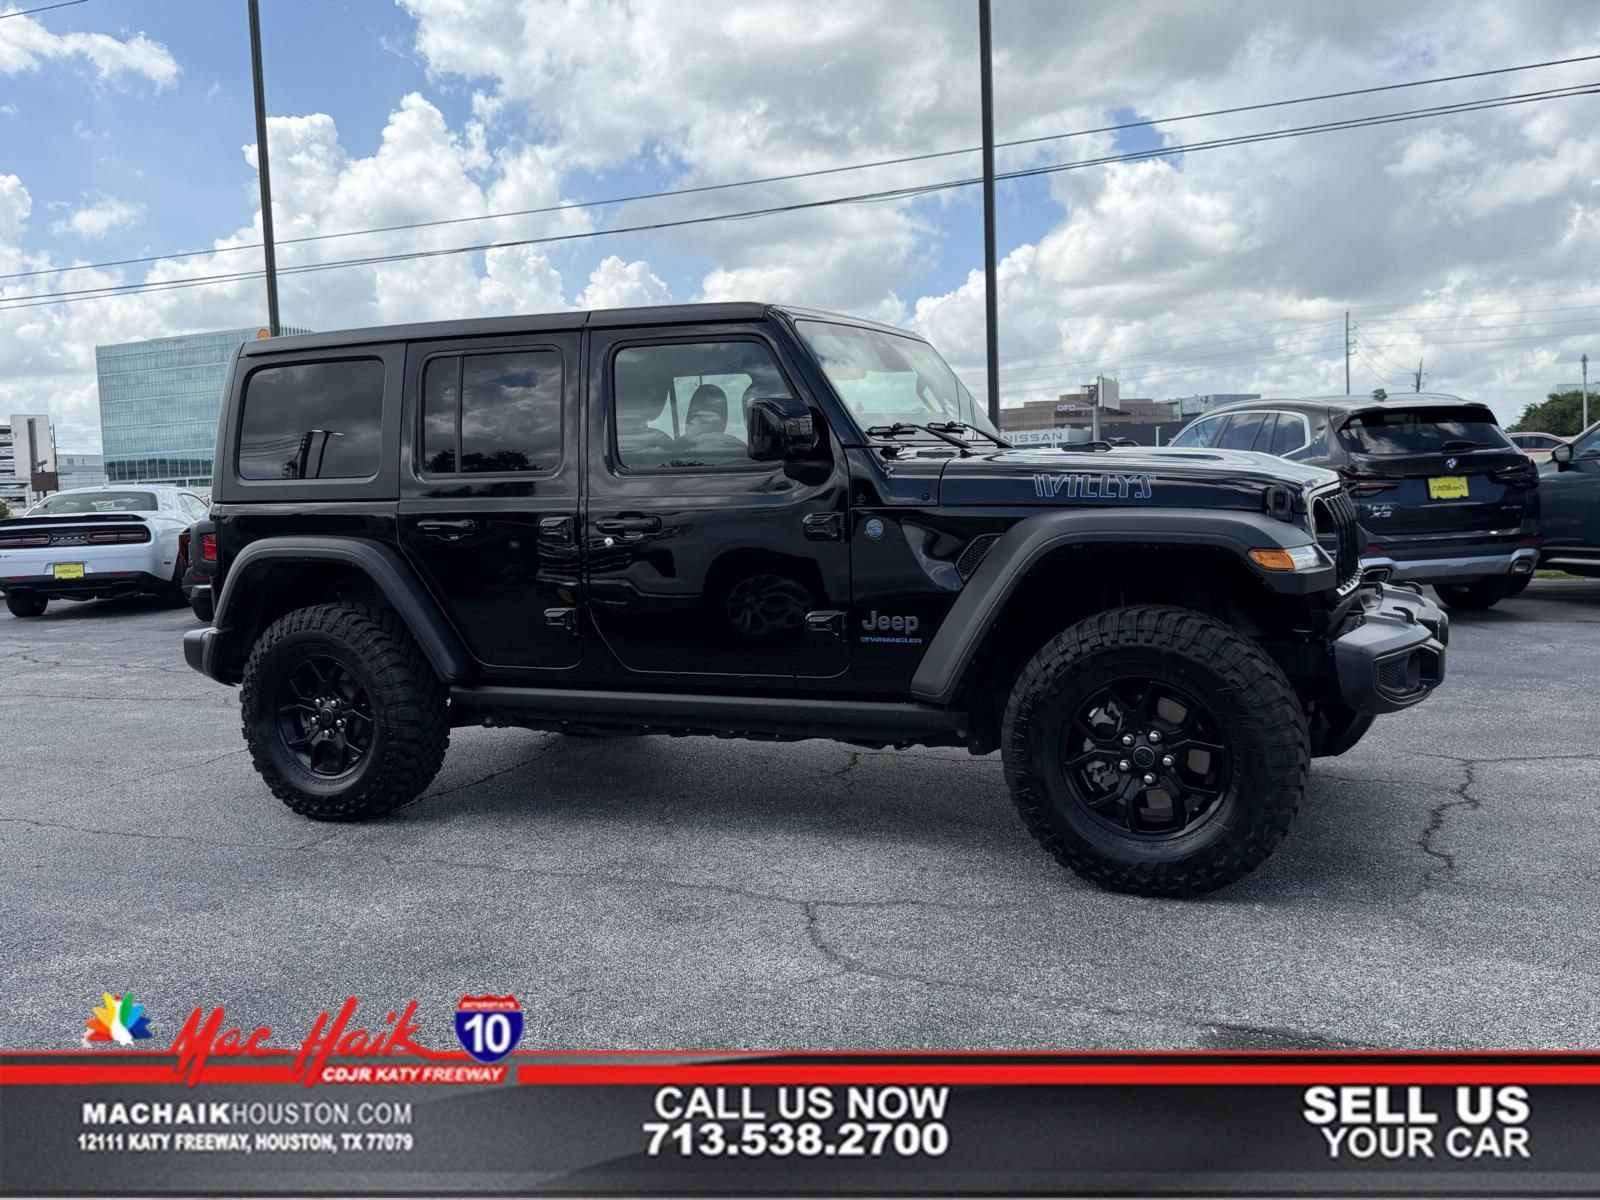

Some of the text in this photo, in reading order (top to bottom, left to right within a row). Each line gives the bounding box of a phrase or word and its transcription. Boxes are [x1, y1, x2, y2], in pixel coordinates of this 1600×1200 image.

[1003, 432, 1062, 443] NISSAN
[1033, 474, 1156, 498] WILLYS
[862, 610, 919, 635] Jeep
